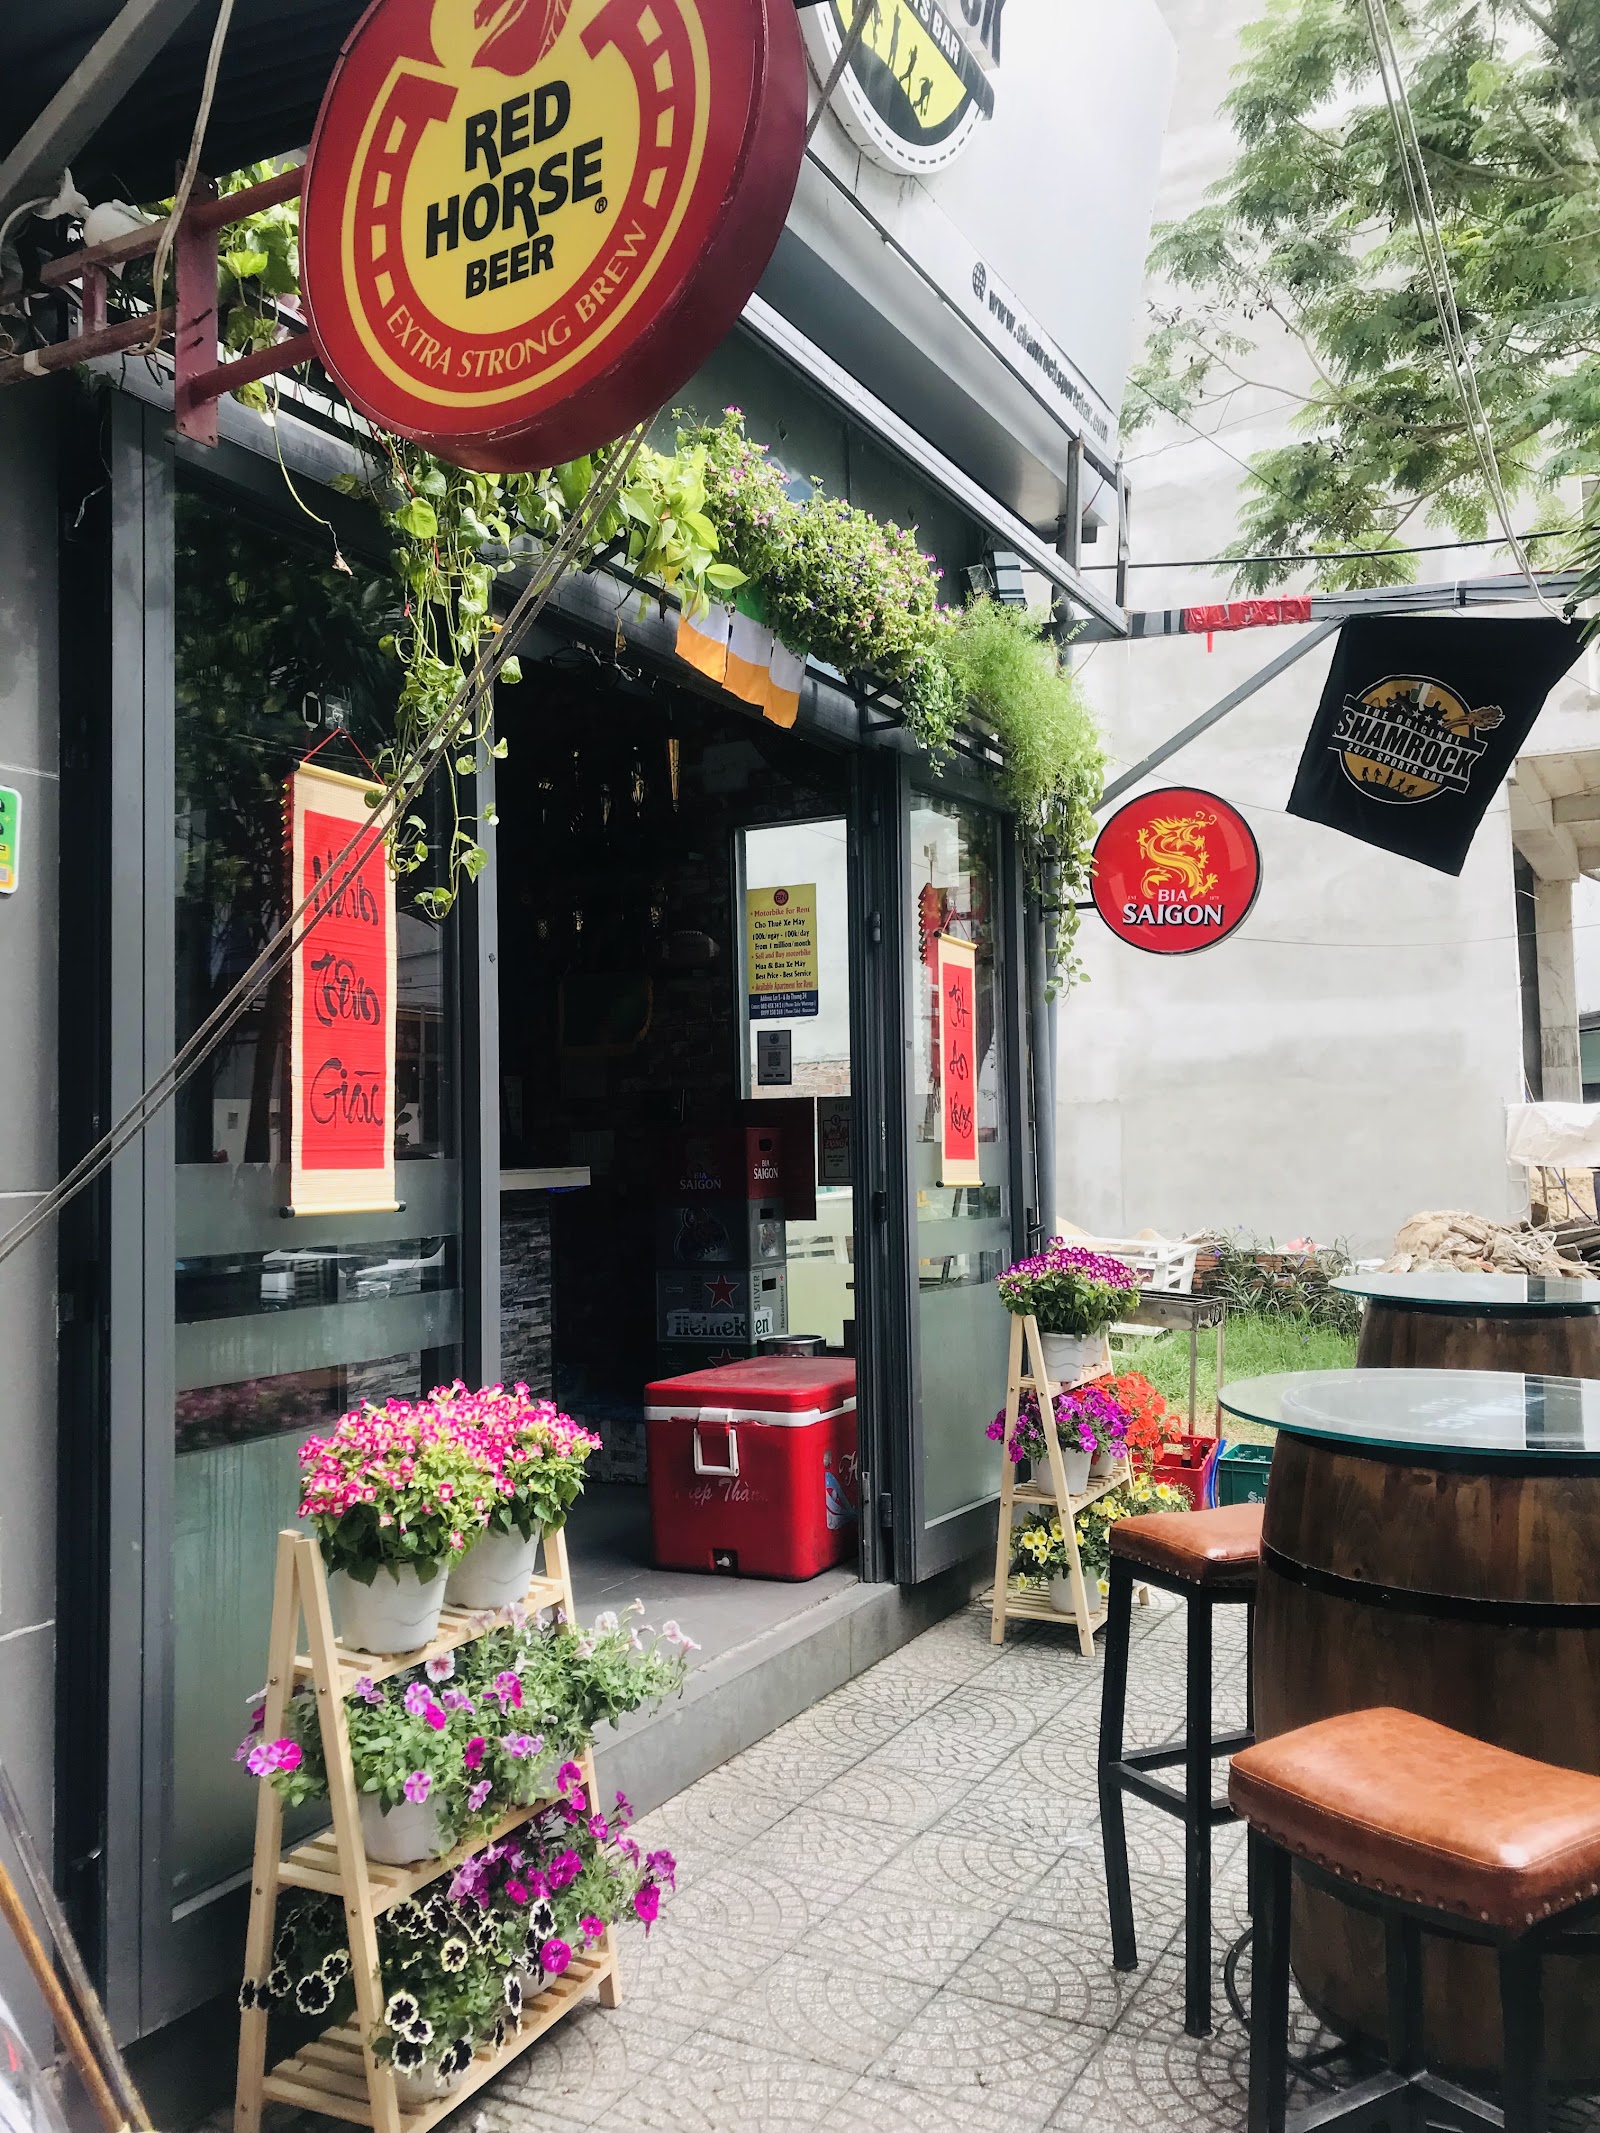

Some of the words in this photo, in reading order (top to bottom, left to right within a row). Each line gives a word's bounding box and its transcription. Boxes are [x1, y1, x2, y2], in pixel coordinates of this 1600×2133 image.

[932, 9, 960, 66] BAR
[465, 79, 571, 180] RED
[425, 136, 603, 259] HORSE
[465, 234, 554, 300] BEER
[386, 303, 452, 377] EXTRA
[456, 316, 573, 380] STRONG
[574, 218, 648, 325] BREW
[1363, 705, 1389, 720] THE
[1395, 714, 1461, 746] ORIGINAL
[1335, 708, 1479, 781] SHAMROCK
[1346, 742, 1372, 758] 24/7
[1376, 752, 1419, 775] SPORTS
[1422, 769, 1445, 785] BAR
[1158, 889, 1188, 902] BIA
[754, 909, 784, 917] Motorbike
[796, 906, 810, 914] Rent
[754, 921, 766, 929] Cho
[1122, 903, 1224, 925] SAIGON
[755, 952, 764, 960] Sell
[765, 951, 775, 959] and
[775, 950, 785, 959] Buy
[785, 948, 811, 957] motorbike
[786, 960, 793, 968] Xe
[766, 971, 779, 979] Price
[794, 969, 812, 977] Service
[679, 1179, 722, 1190] SAIGON
[753, 1164, 779, 1180] SAIGON
[753, 1275, 761, 1311] SILVER
